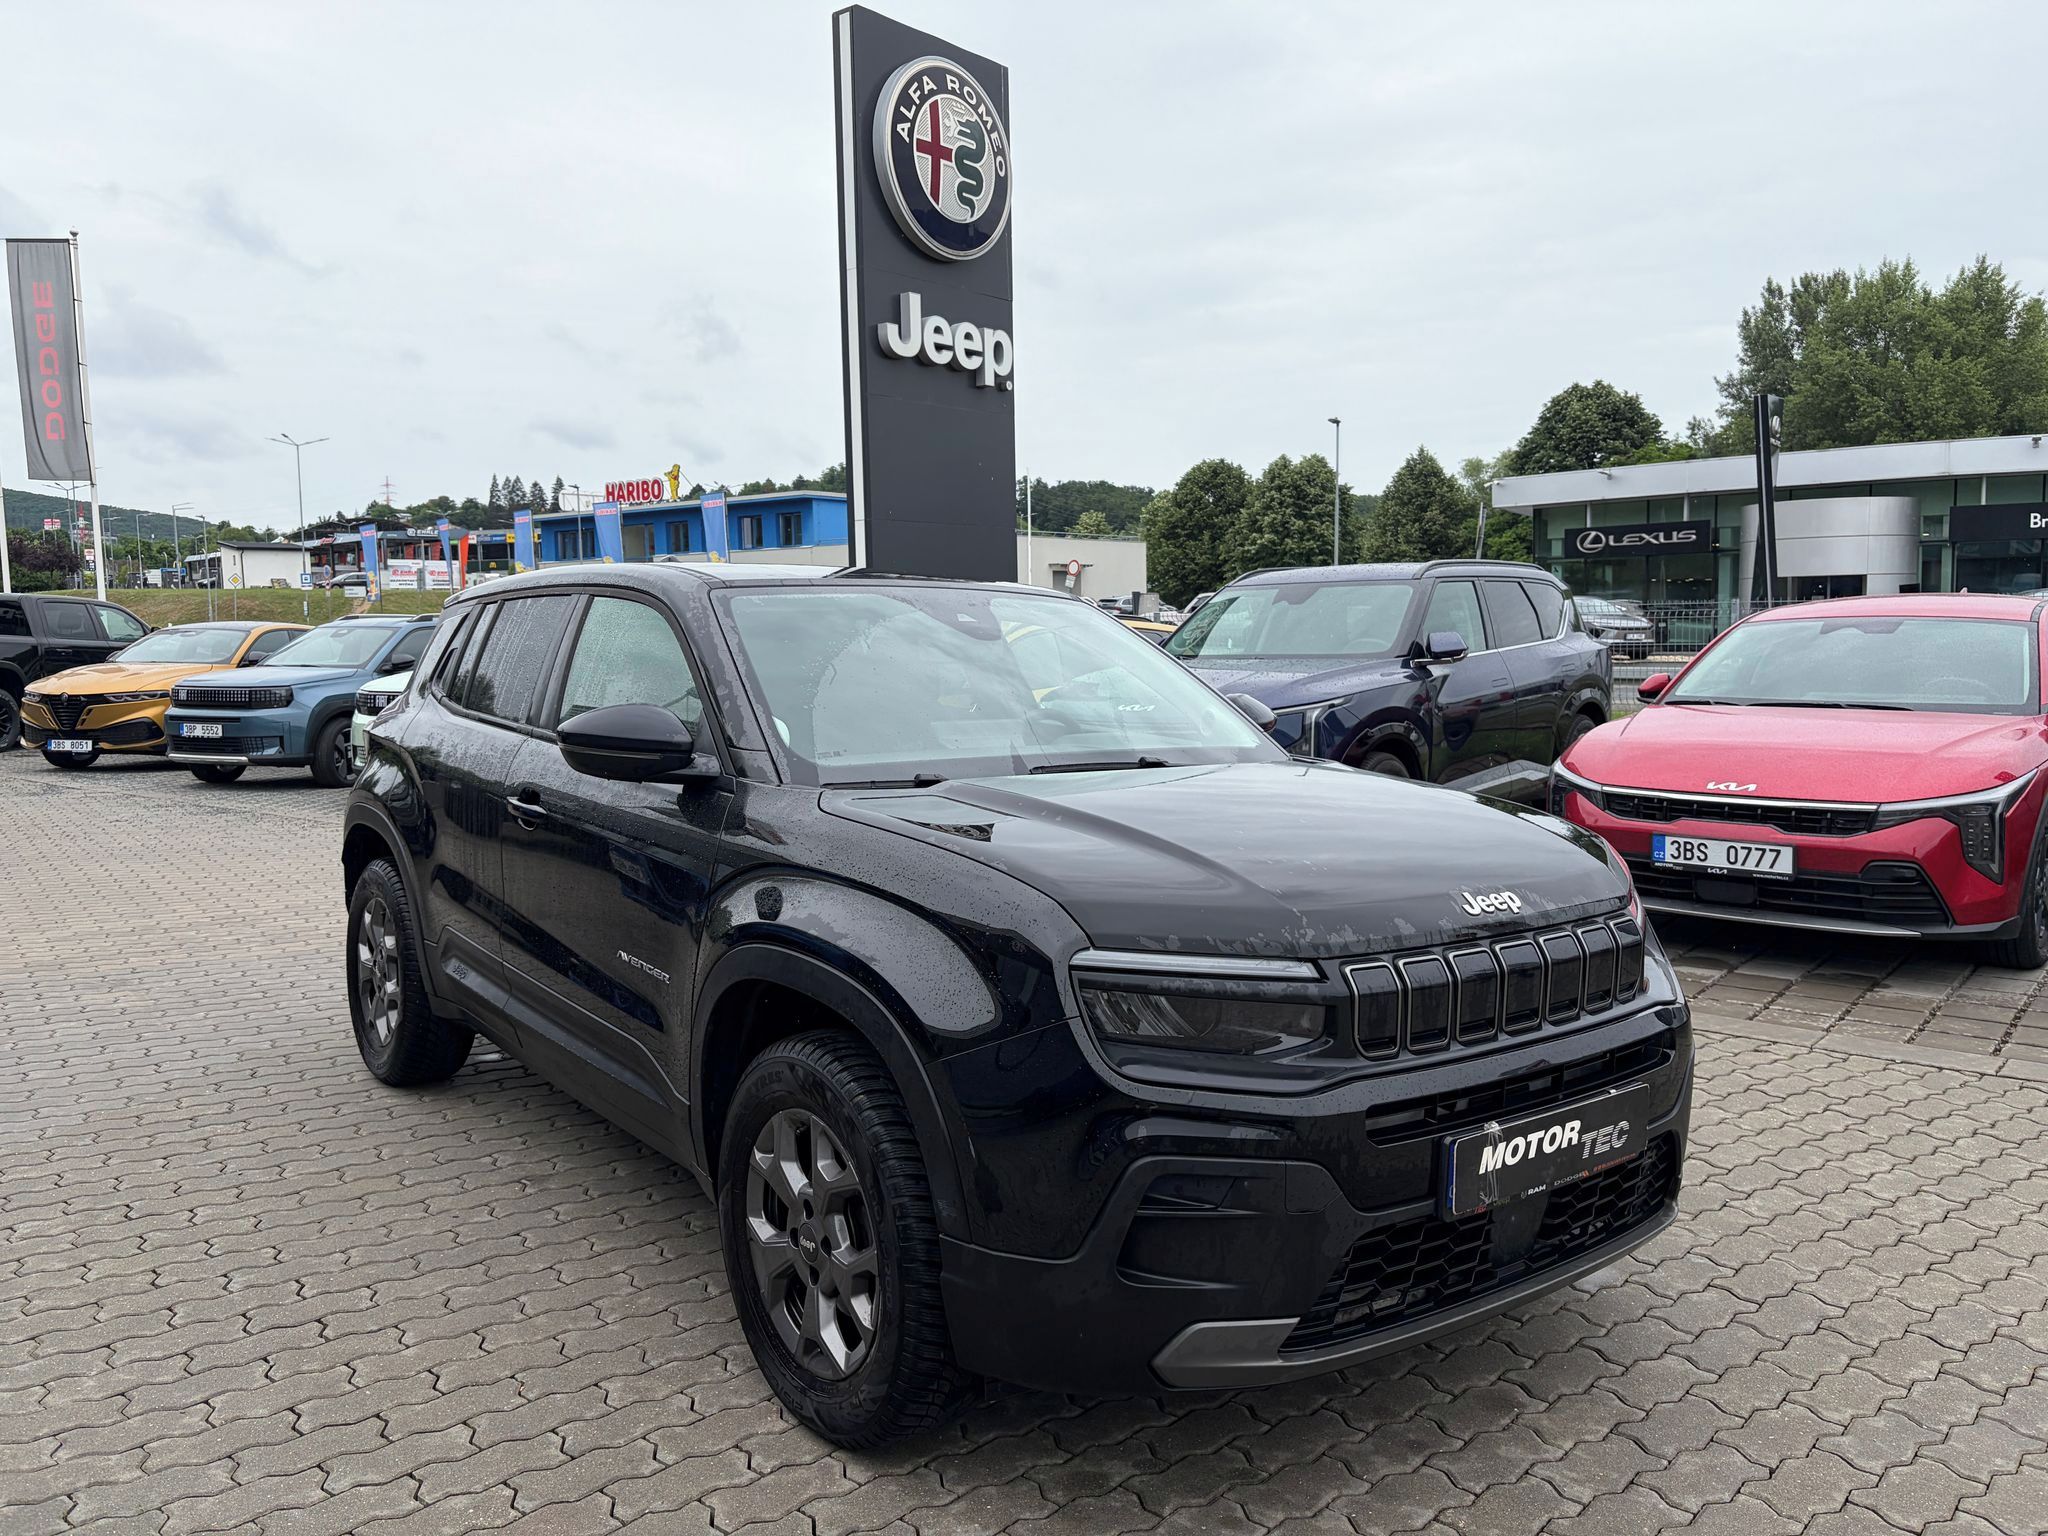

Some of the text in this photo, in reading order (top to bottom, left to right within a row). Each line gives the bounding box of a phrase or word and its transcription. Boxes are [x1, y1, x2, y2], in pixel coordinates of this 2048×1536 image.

[897, 73, 1006, 178] ALFA ROMEO
[877, 291, 1013, 388] Jeep
[33, 280, 66, 441] DODGE
[605, 478, 663, 502] HARIBO
[1608, 530, 1696, 546] LEXUS
[202, 726, 219, 735] 5552
[71, 741, 88, 749] 8051
[1670, 840, 1708, 862] 3BS
[1726, 845, 1781, 869] 0777
[1461, 891, 1521, 916] Jeep
[616, 950, 670, 984] AVENGER
[1479, 1120, 1581, 1175] MOTOR
[1581, 1121, 1629, 1159] TEC
[1527, 1184, 1547, 1195] RAM
